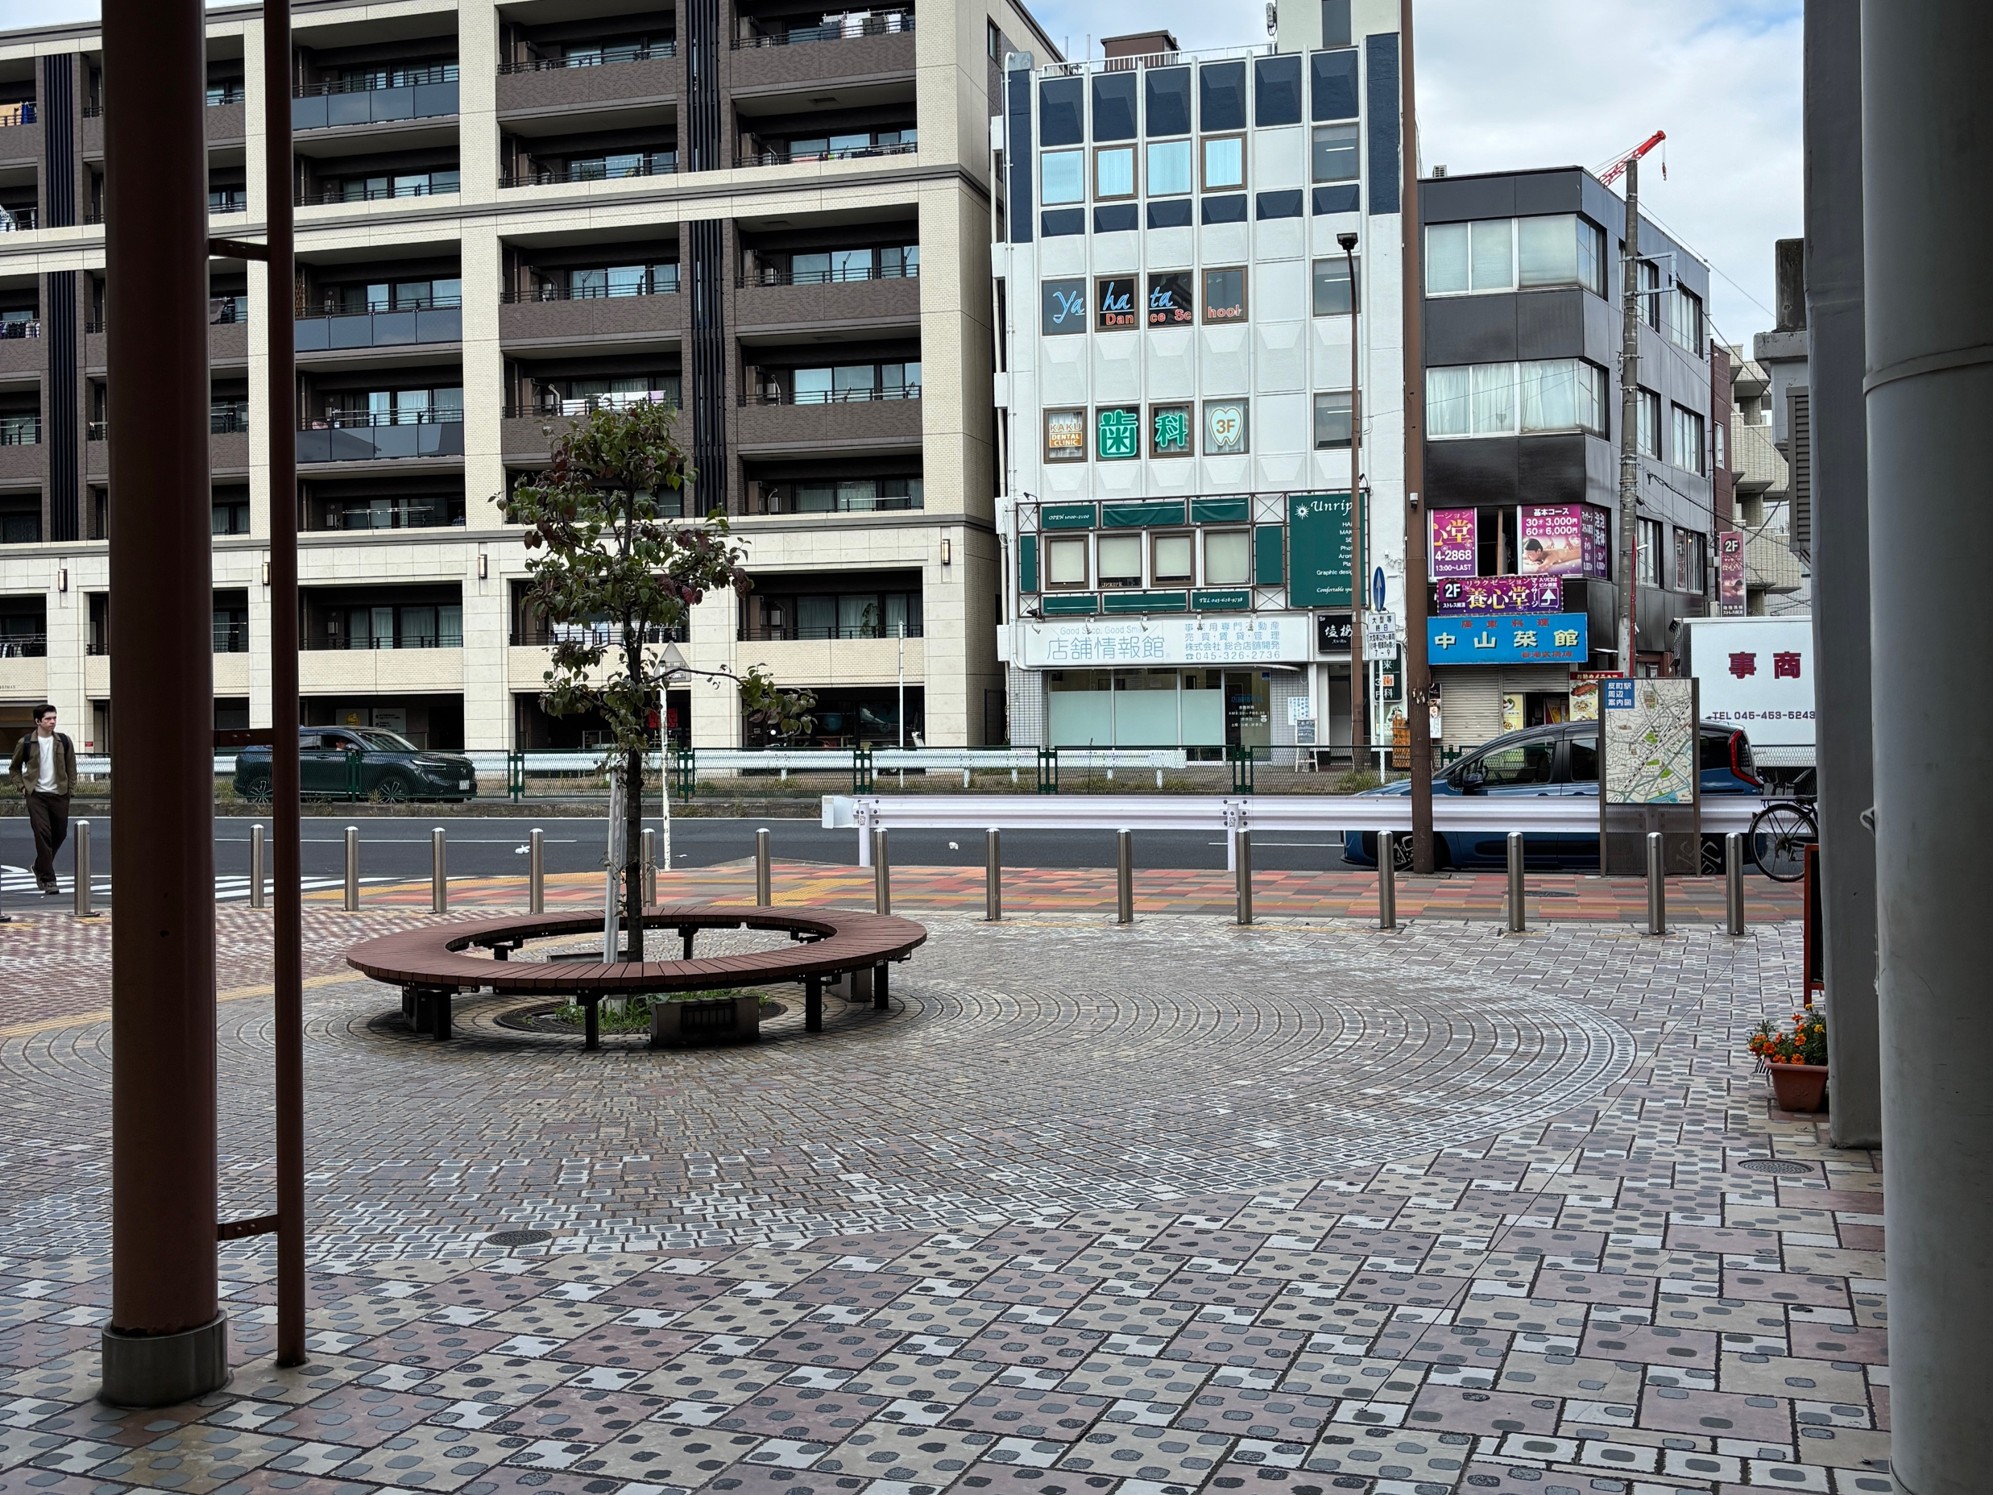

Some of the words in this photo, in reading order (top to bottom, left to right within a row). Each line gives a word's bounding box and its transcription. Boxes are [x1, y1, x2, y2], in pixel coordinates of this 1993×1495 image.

[1050, 423, 1082, 432] KAKU
[1216, 419, 1236, 434] 3F
[1311, 500, 1352, 516] Unrip
[1534, 508, 1570, 516] 基本コース
[1724, 540, 1739, 552] 2F
[1435, 550, 1472, 561] 4-2868
[1467, 577, 1531, 587] リラクゼーション
[1445, 583, 1461, 598] 2F
[1467, 586, 1530, 610] 養心堂
[1060, 626, 1080, 635] Good
[1104, 625, 1125, 635] Good
[1434, 628, 1579, 650] 中山菜館
[1195, 651, 1280, 660] 045-326-2736
[1712, 711, 1732, 720] TEL
